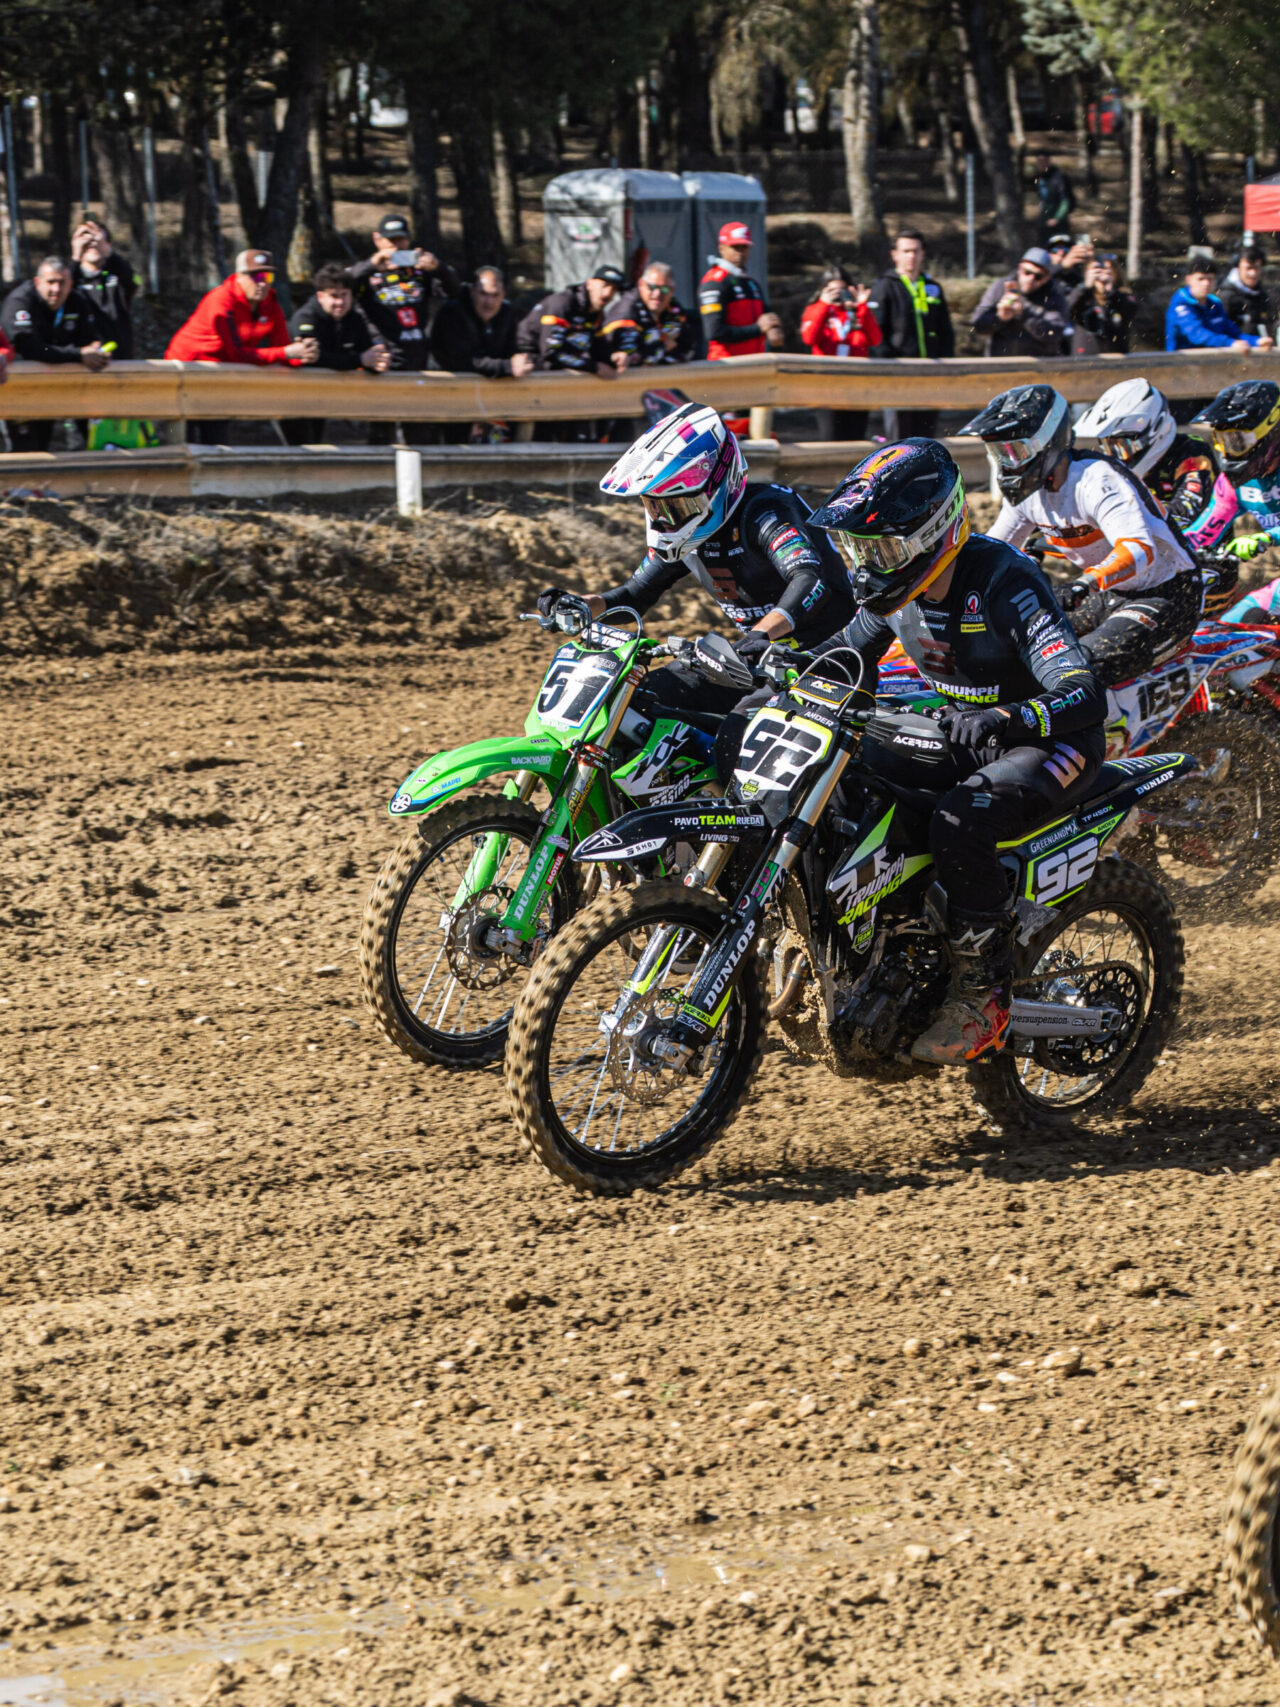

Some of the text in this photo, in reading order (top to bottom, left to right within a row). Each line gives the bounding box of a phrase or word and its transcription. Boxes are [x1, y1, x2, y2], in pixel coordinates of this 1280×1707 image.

[696, 648, 725, 673] CERBIS
[536, 663, 615, 723] 51
[933, 680, 1000, 696] TRIUMPH
[803, 710, 834, 727] ANDER
[892, 734, 943, 751] ACERBIS
[510, 755, 552, 766] BACKYARD
[1135, 769, 1176, 796] DUNLOP
[634, 841, 658, 851] SHOT
[700, 833, 729, 842] LIVING
[513, 845, 550, 922] DUNLOP
[546, 854, 565, 886] MOTUL
[844, 852, 905, 913] TRIUMPH
[1036, 837, 1098, 905] 92
[837, 872, 903, 926] RACING
[703, 919, 756, 1012] DUNLOP
